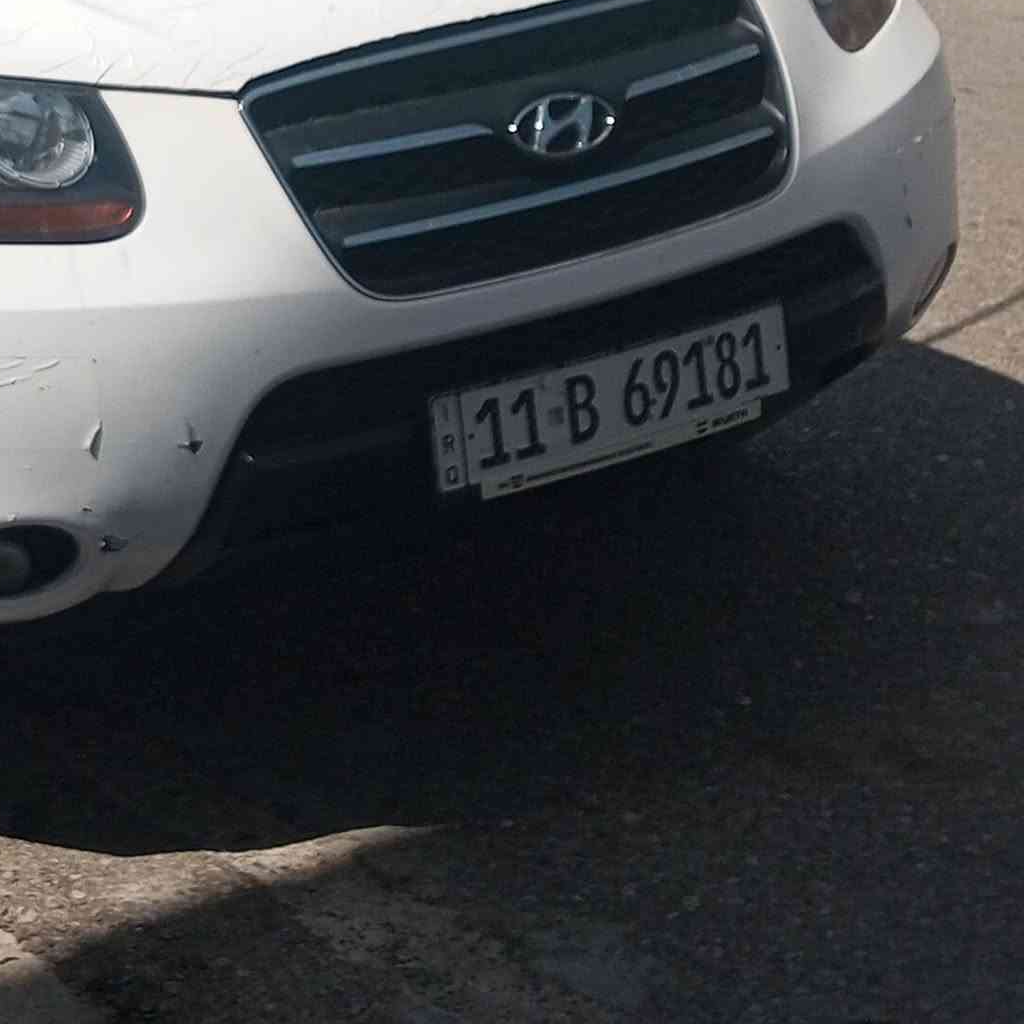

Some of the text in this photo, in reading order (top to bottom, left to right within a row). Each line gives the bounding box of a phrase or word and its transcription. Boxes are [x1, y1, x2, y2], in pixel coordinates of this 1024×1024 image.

[474, 322, 771, 470] 11 B 69181
